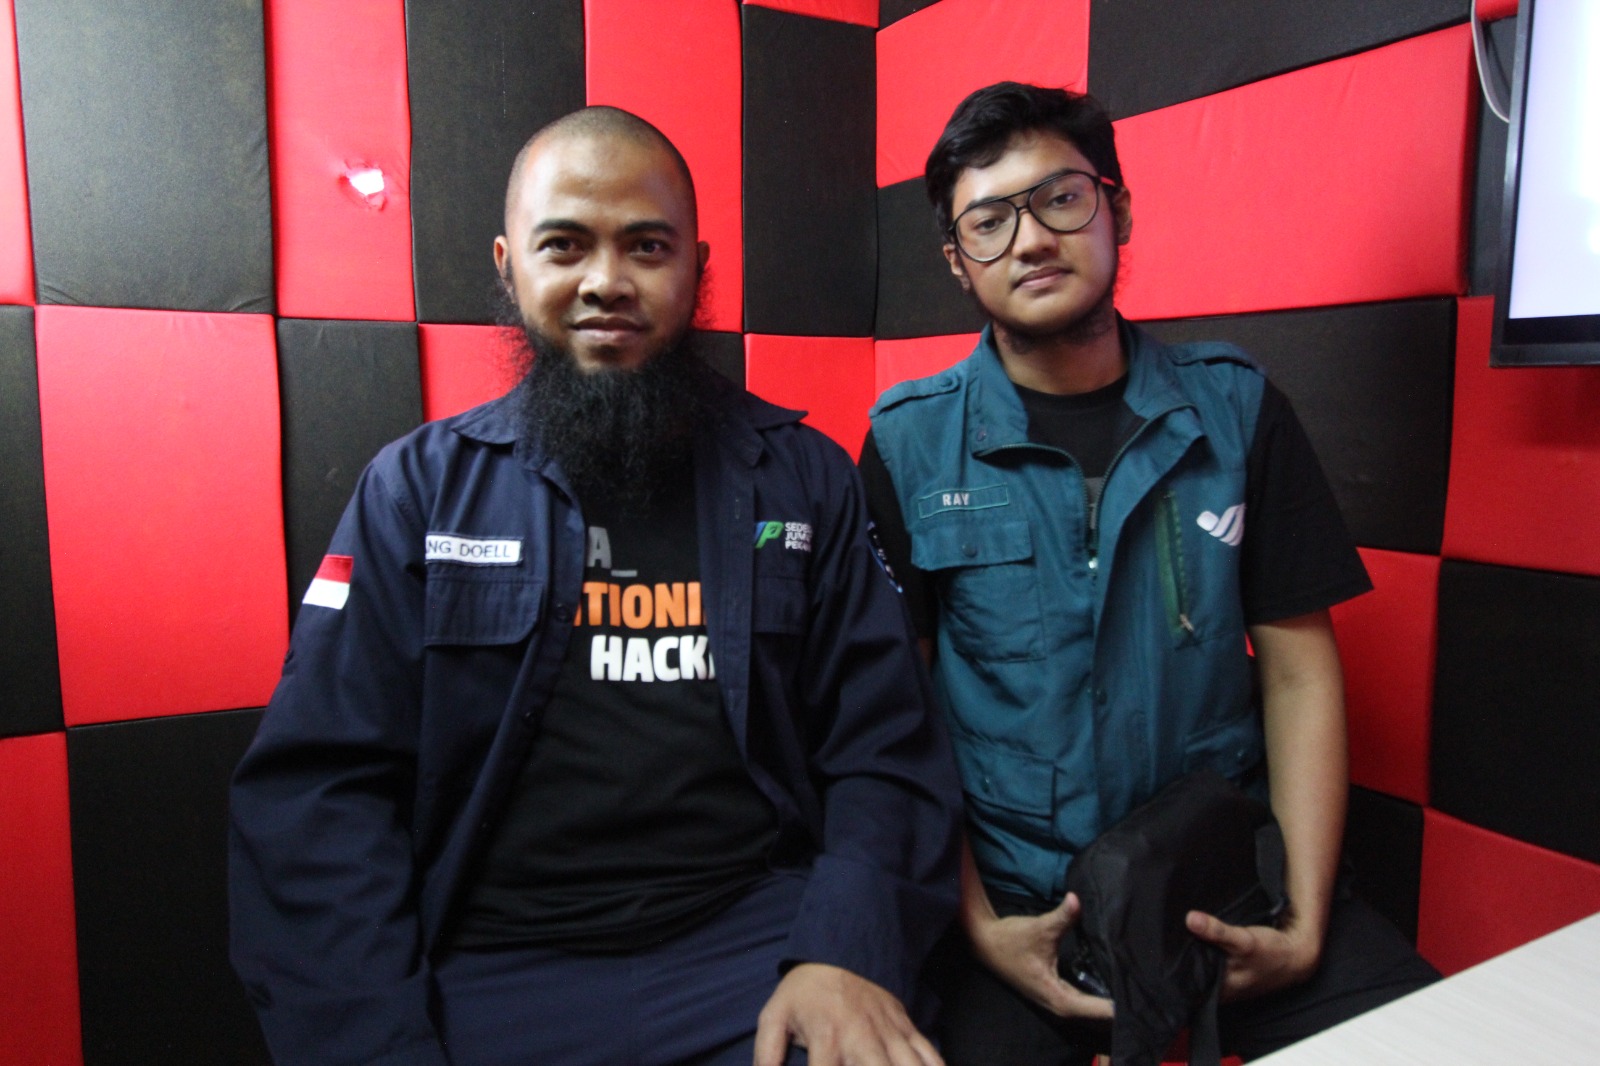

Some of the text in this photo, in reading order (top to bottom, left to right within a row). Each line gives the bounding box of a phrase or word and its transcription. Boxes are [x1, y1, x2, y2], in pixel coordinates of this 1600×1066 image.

[942, 492, 970, 506] RAY
[785, 521, 812, 533] SEDE
[785, 531, 811, 542] JUM
[459, 543, 511, 559] DOELL
[573, 581, 707, 629] TIONI
[590, 634, 716, 682] HACK
